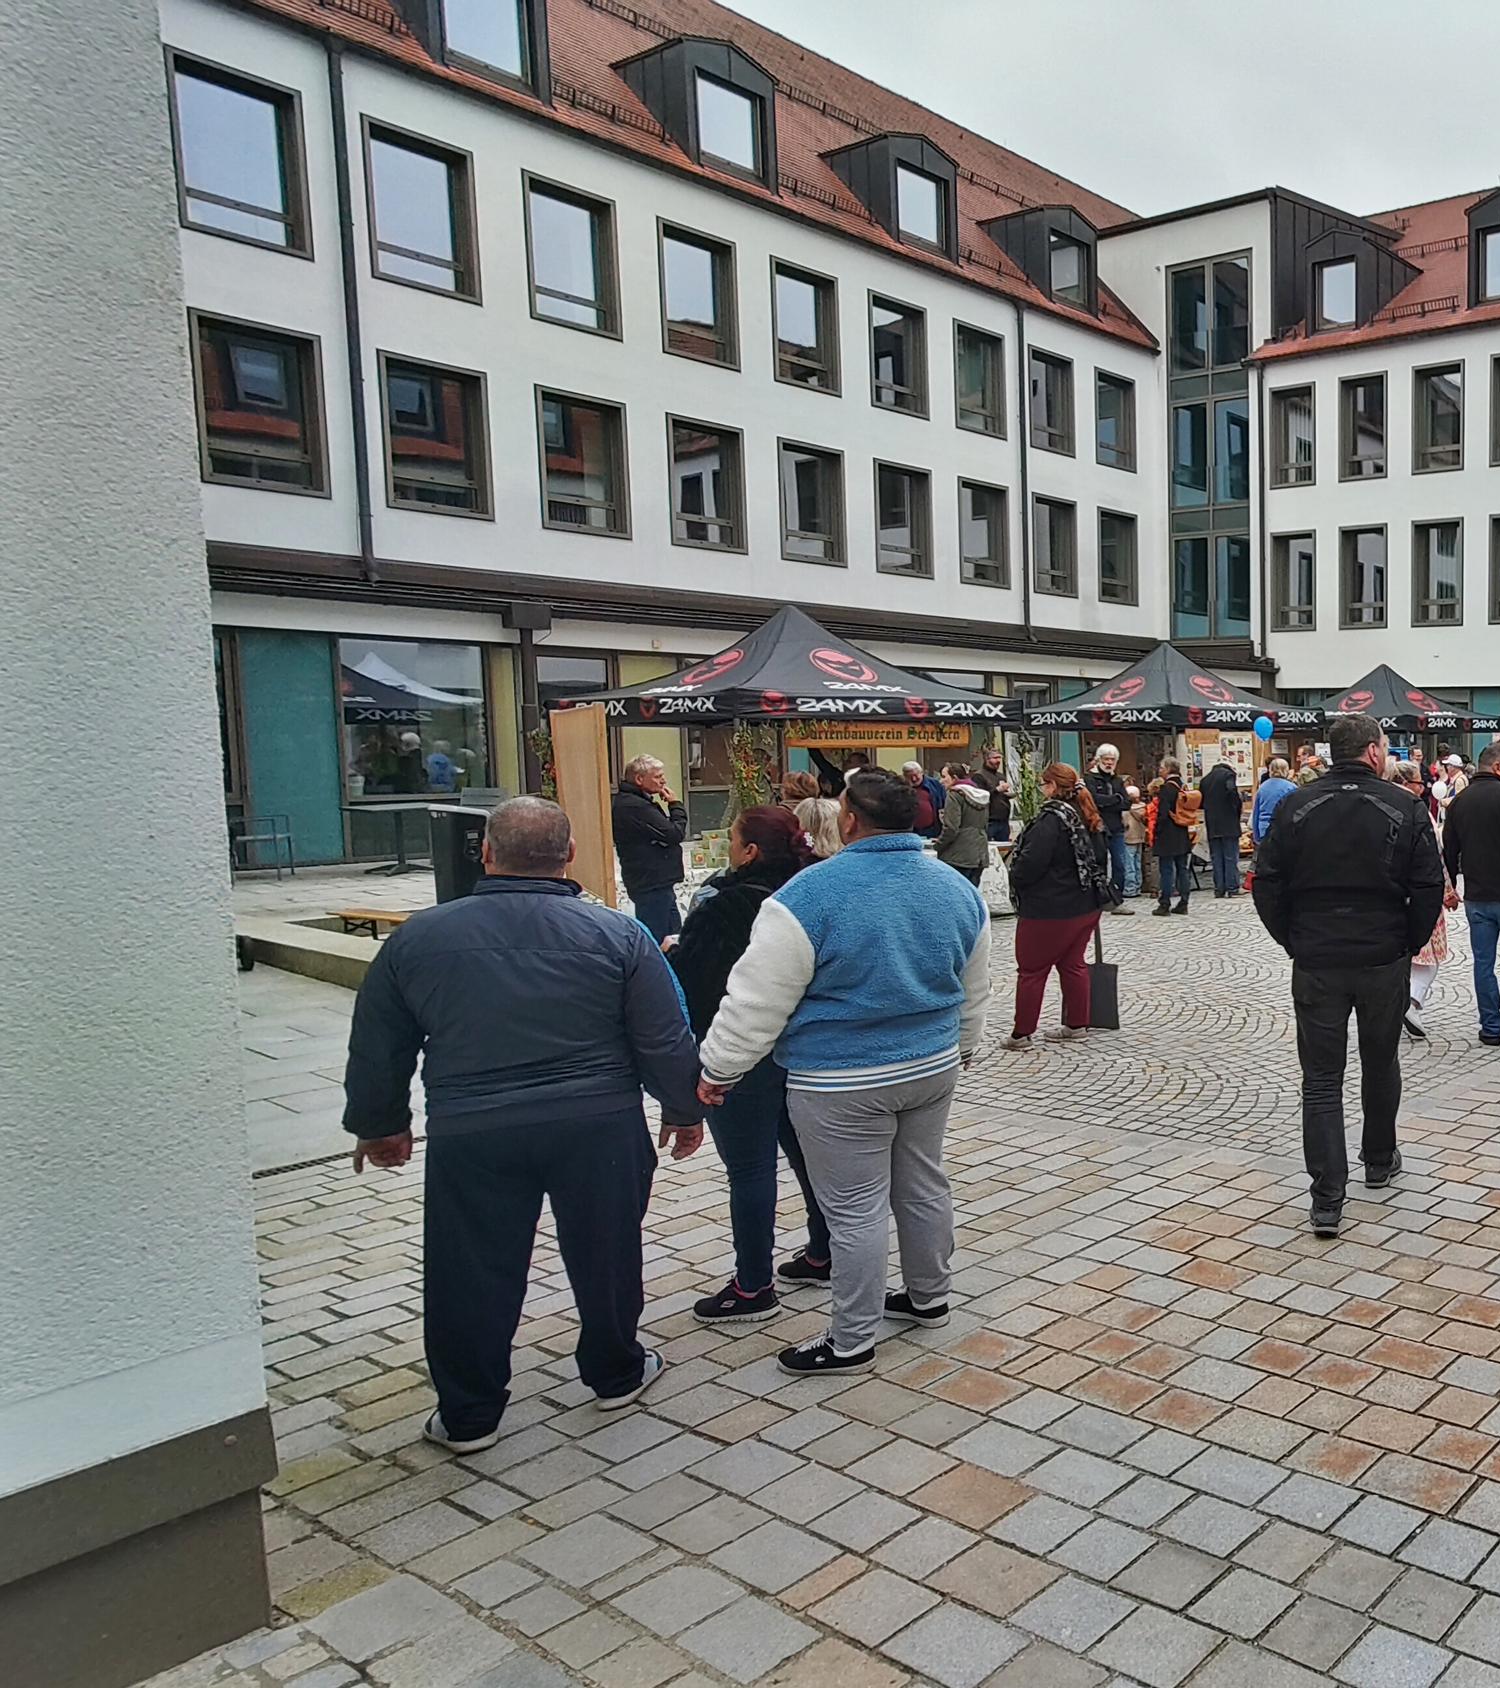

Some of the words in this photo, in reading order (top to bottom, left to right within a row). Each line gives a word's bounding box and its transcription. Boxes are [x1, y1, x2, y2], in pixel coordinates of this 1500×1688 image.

[659, 696, 717, 714] 24MX
[796, 698, 887, 715] 24MX
[934, 701, 1007, 718] 24MX
[1031, 711, 1079, 726] 24MX
[1110, 709, 1163, 723] 24MX
[1206, 710, 1252, 723] 24MX
[1278, 711, 1319, 724] 24MX
[1427, 718, 1457, 728] 24MX
[1472, 719, 1499, 729] 24MX
